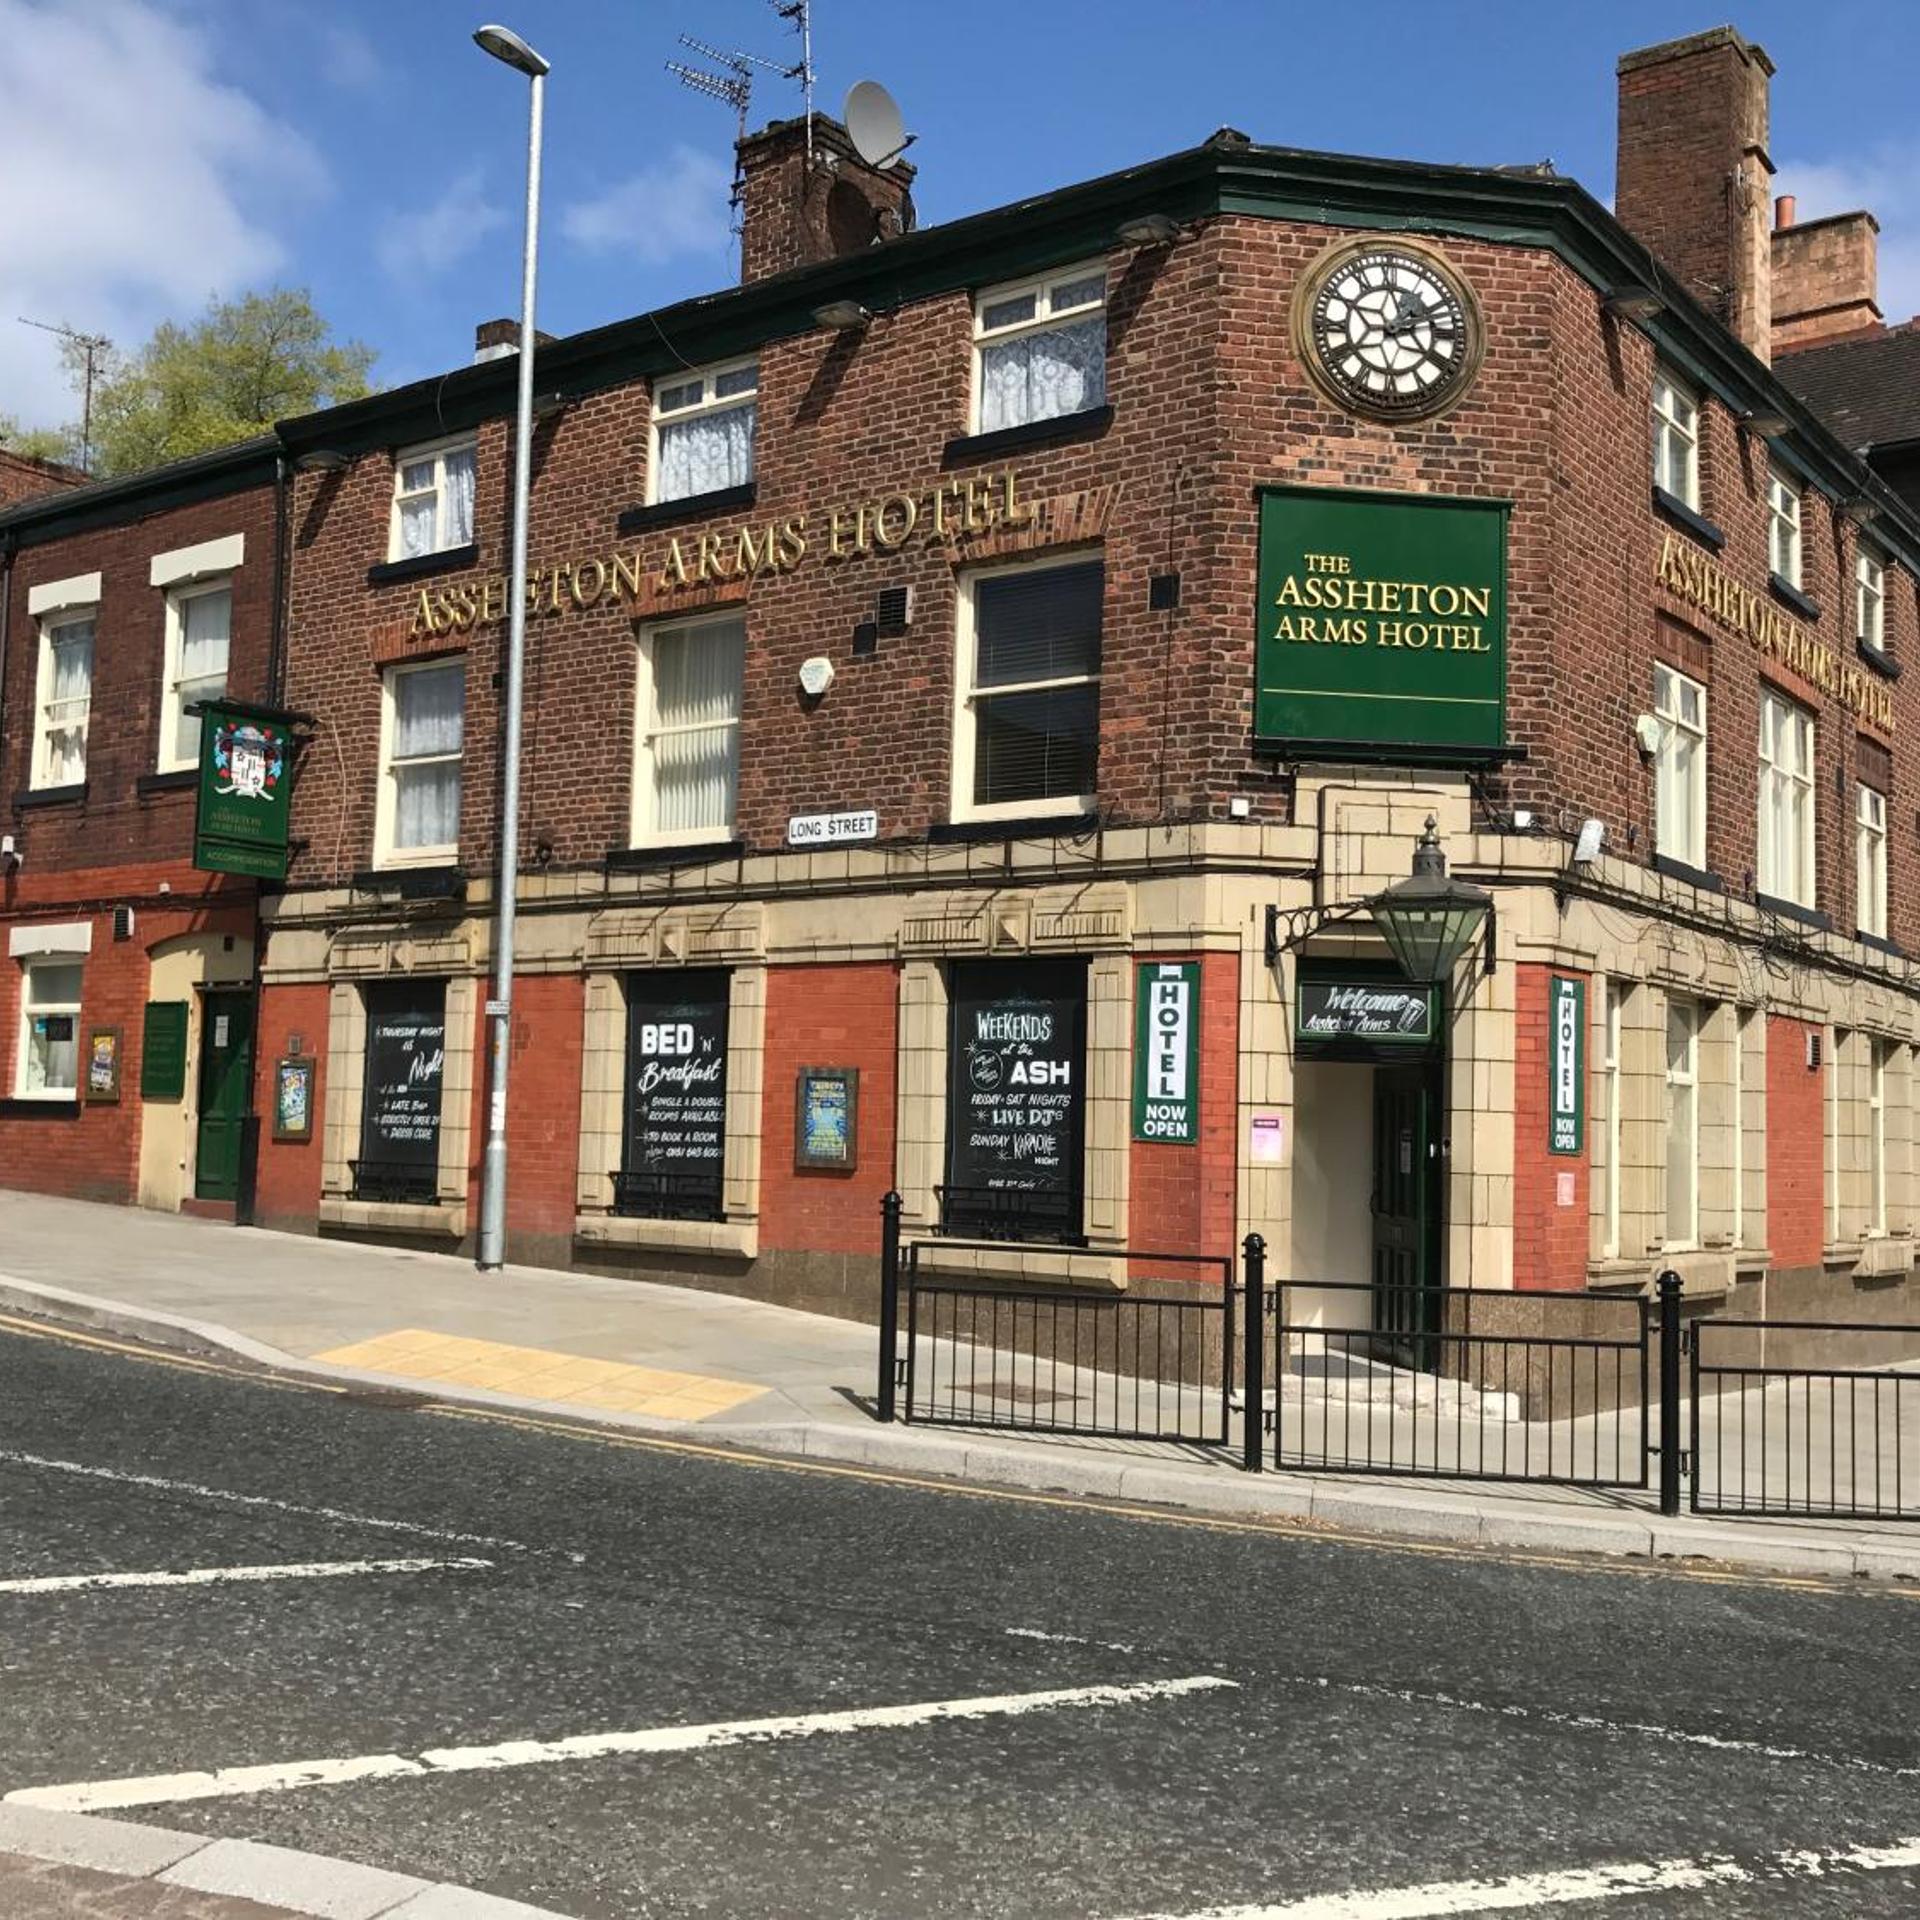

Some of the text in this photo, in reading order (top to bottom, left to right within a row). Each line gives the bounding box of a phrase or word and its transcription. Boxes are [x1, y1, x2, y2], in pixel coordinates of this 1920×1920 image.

[660, 514, 807, 587] ARMS
[827, 466, 1040, 556] HOTEL
[1304, 554, 1351, 574] THE
[1276, 575, 1491, 618] ASSHETON
[1273, 616, 1491, 651] ARMS HOTEL
[790, 817, 875, 838] LONG STREET
[1325, 986, 1410, 1012] Welcome
[1354, 1015, 1391, 1033] Arms
[641, 1024, 694, 1055] BED
[1158, 984, 1180, 1096] HOTEL
[1561, 1002, 1572, 1110] HOTEL
[638, 1058, 722, 1094] Breakfast
[1010, 1061, 1070, 1085] ASH
[391, 1100, 411, 1110] LATE
[651, 1096, 682, 1107] SINGLE
[1005, 1094, 1026, 1105] SAT
[1028, 1093, 1072, 1107] NIGHTS
[648, 1110, 680, 1122] ROOMS
[993, 1109, 1025, 1126] LIVE
[1145, 1104, 1187, 1121] NOW
[1143, 1121, 1188, 1137] OPEN
[1556, 1118, 1575, 1133] NOW
[661, 1131, 682, 1142] BOOK
[692, 1131, 717, 1143] ROOM
[970, 1134, 1010, 1147] SUNDAY
[1555, 1133, 1575, 1149] OPEN
